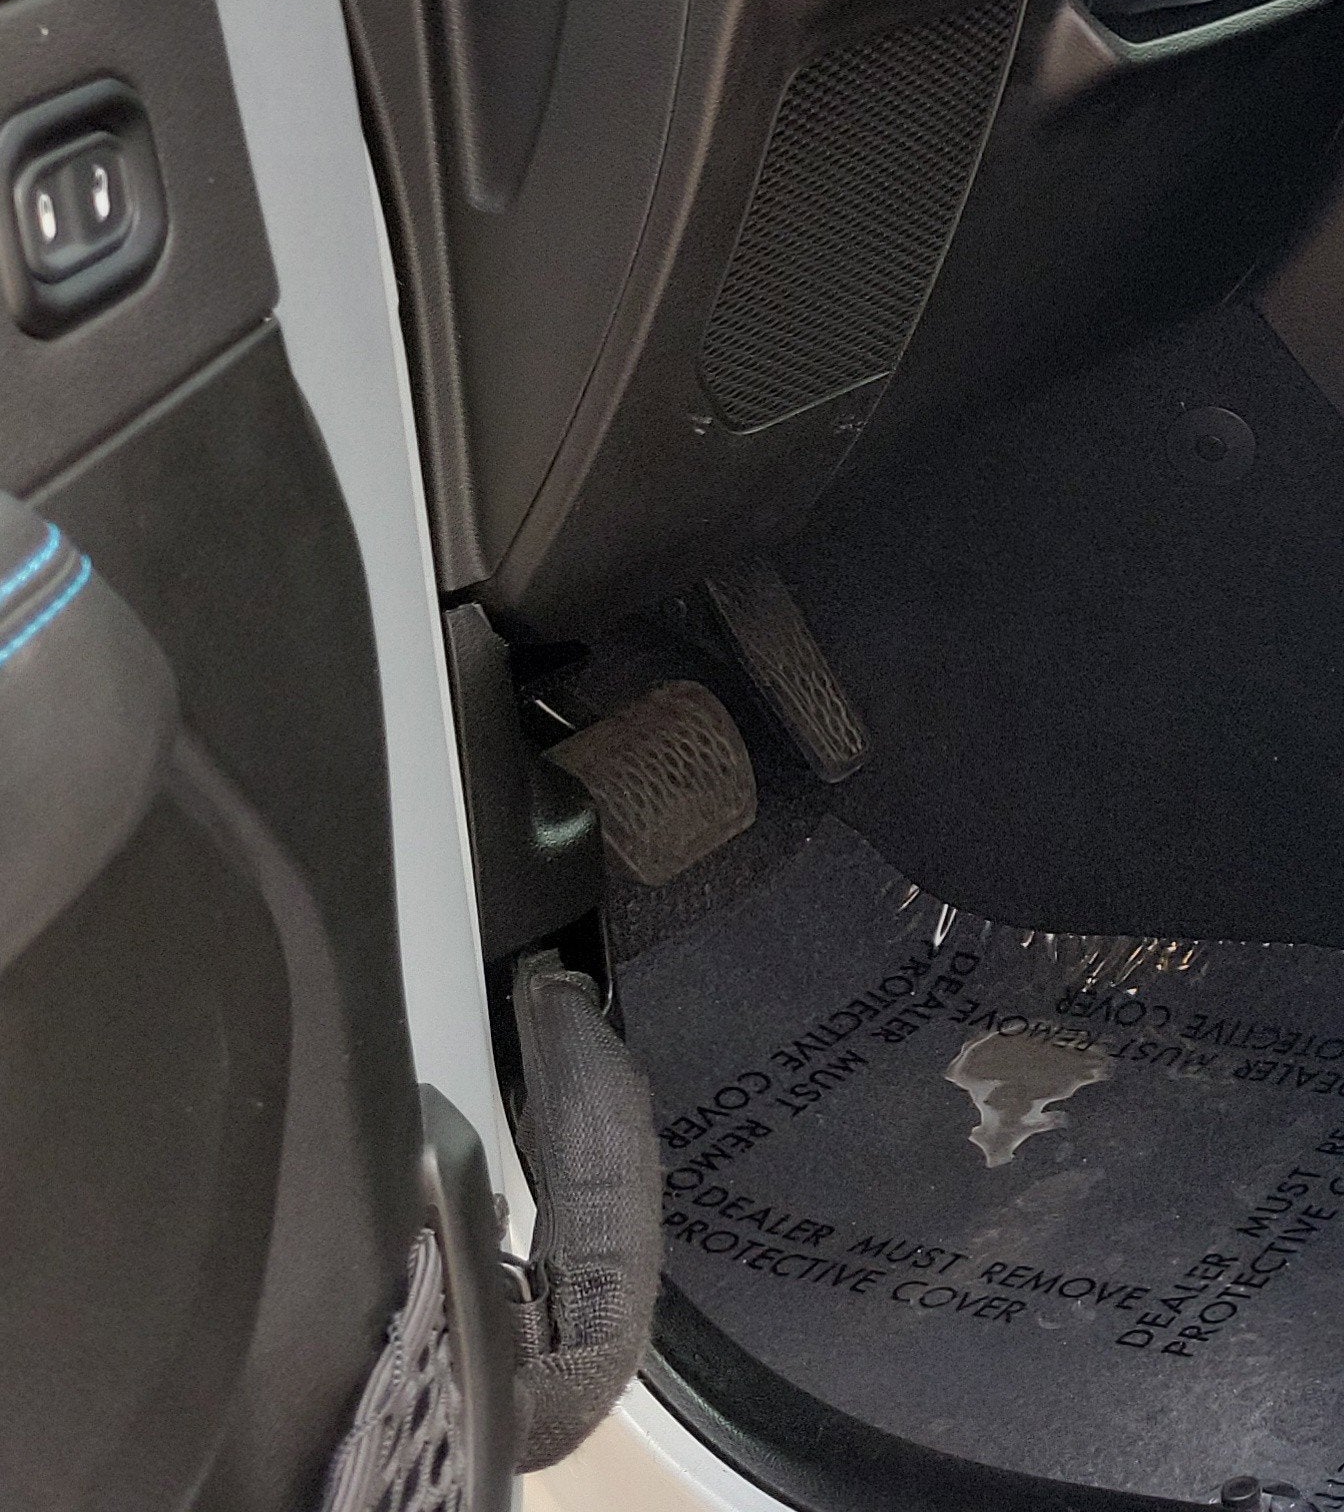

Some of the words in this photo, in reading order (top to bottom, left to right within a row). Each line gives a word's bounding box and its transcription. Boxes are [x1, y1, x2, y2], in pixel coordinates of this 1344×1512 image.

[869, 950, 980, 1044] DEALER
[949, 998, 1103, 1052] REMOVE
[1055, 987, 1171, 1028] COVER
[658, 1070, 771, 1150] COVER
[777, 1050, 869, 1117] MUST
[662, 1119, 773, 1209] REMO
[662, 1210, 886, 1294] PROTECTIVE
[892, 1280, 1028, 1324] COVER
[692, 1186, 836, 1246] DEALER
[848, 1235, 971, 1273] MUST
[980, 1261, 1150, 1311] REMOVE
[1115, 1253, 1239, 1348] DEALER
[1236, 1167, 1322, 1238] MUST
[1162, 1205, 1338, 1358] PROTECTIVE
